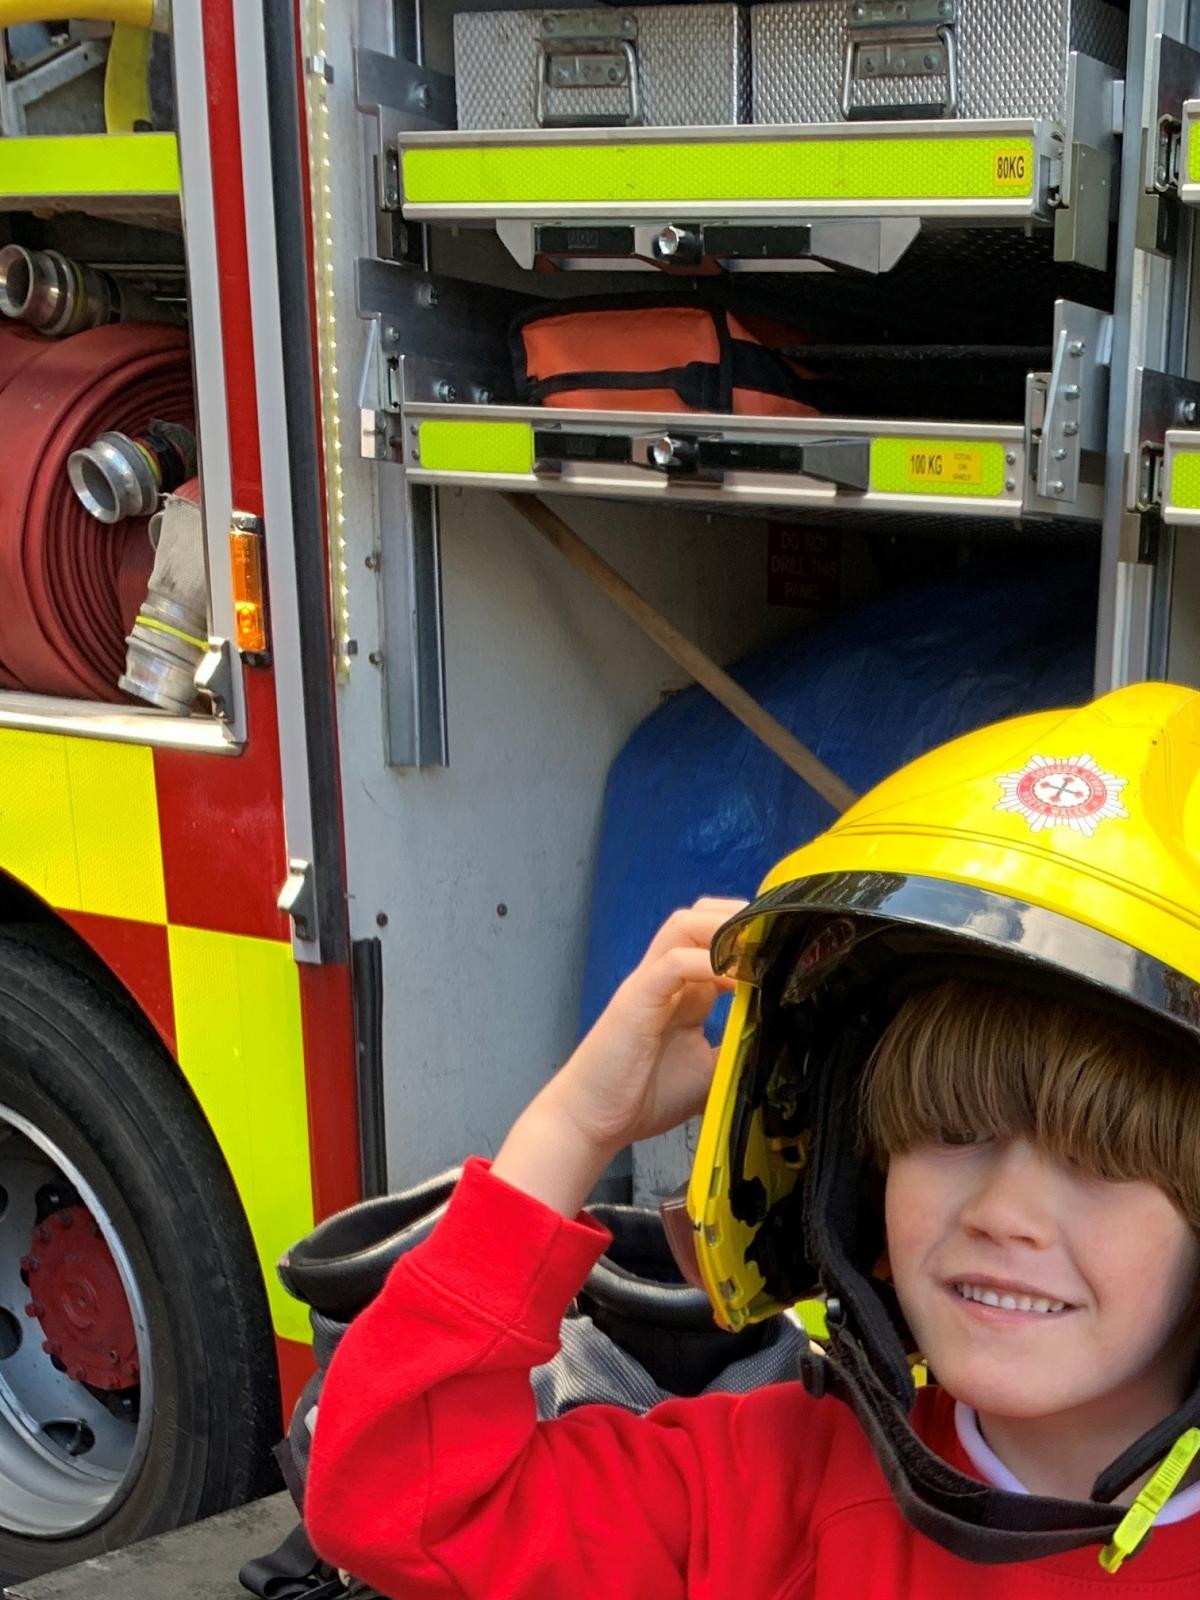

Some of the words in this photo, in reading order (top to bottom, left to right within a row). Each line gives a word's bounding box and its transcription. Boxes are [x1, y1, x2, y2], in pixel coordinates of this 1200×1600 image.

[997, 156, 1025, 179] 80KG
[911, 454, 926, 475] 100
[928, 455, 943, 476] KG
